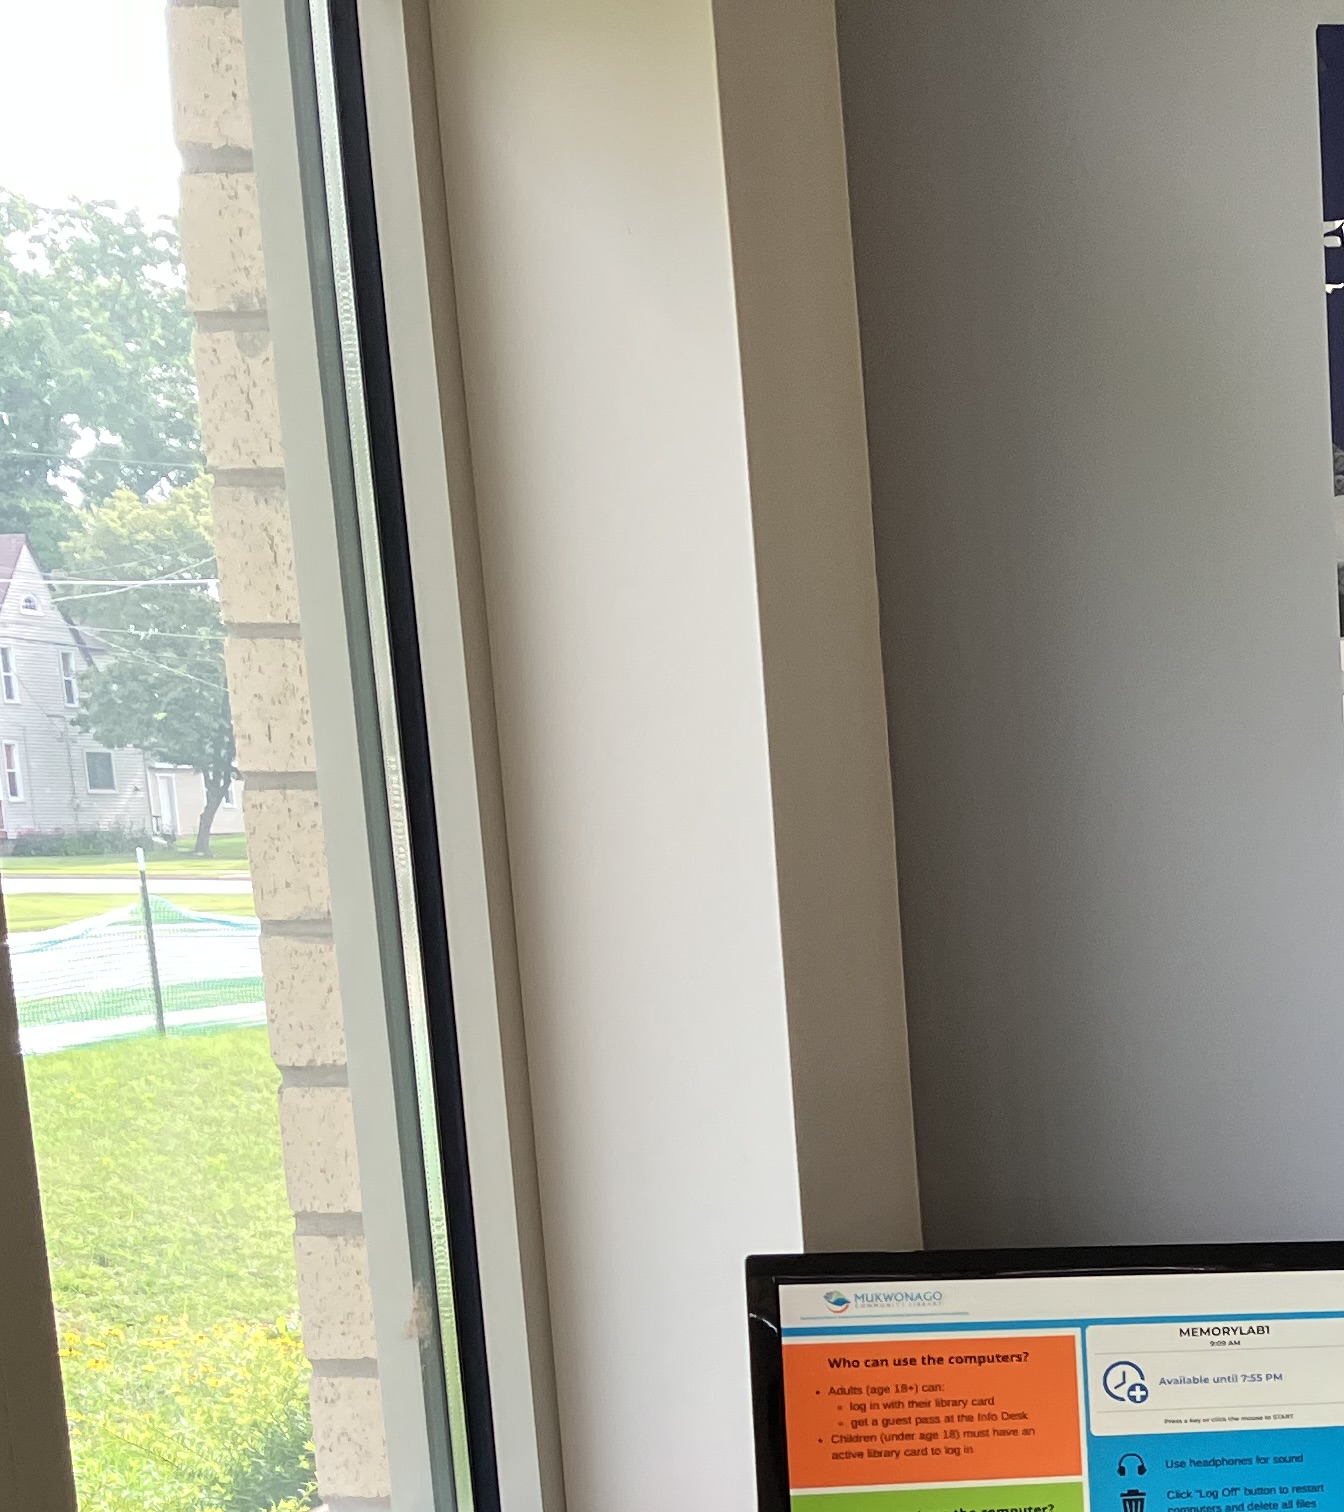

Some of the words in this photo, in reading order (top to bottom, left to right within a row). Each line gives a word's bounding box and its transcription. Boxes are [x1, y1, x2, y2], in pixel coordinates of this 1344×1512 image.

[853, 1290, 943, 1302] MUKWONAGO
[1179, 1325, 1270, 1337] MEMORYLAB1
[827, 1357, 861, 1369] Who
[863, 1358, 889, 1368] can
[892, 1357, 917, 1367] use
[921, 1354, 944, 1366] the
[948, 1351, 1030, 1367] computers?
[1158, 1375, 1210, 1386] Available
[1212, 1374, 1238, 1384] until
[1240, 1373, 1263, 1383] 7:55
[1265, 1373, 1283, 1382] PM
[827, 1385, 863, 1396] Adults
[865, 1385, 891, 1397] (age
[894, 1383, 919, 1395] 18+)
[921, 1383, 944, 1393] can:
[1164, 1459, 1187, 1469] Use
[1188, 1456, 1254, 1469] headphones
[1255, 1455, 1270, 1465] for
[1272, 1453, 1304, 1465] sound
